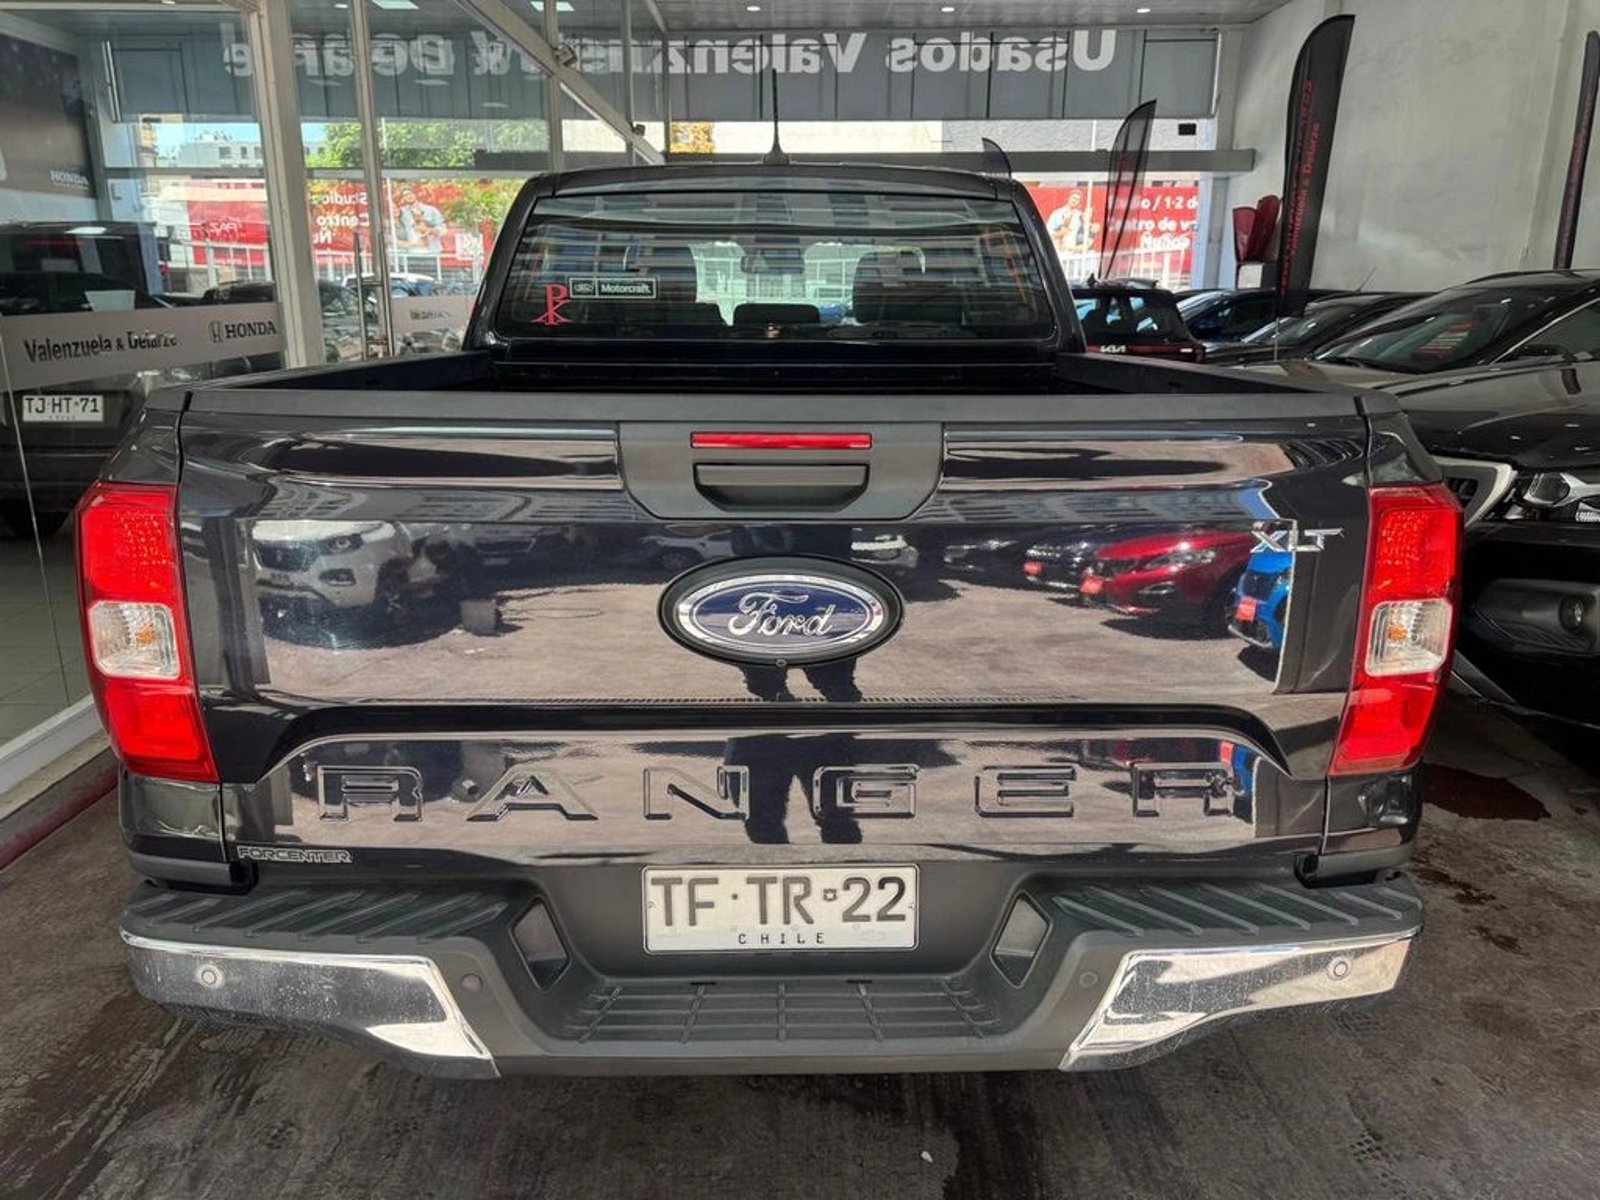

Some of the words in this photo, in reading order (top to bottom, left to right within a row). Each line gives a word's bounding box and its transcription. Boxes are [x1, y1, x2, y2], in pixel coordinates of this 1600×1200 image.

[224, 320, 278, 339] HONDA
[23, 333, 112, 363] Valenzuela
[115, 336, 124, 350] &
[1249, 528, 1343, 552] XLT
[728, 592, 836, 636] Ford
[317, 764, 1235, 819] RANGER
[237, 846, 352, 863] FORCENTER
[737, 932, 825, 945] CHILE
